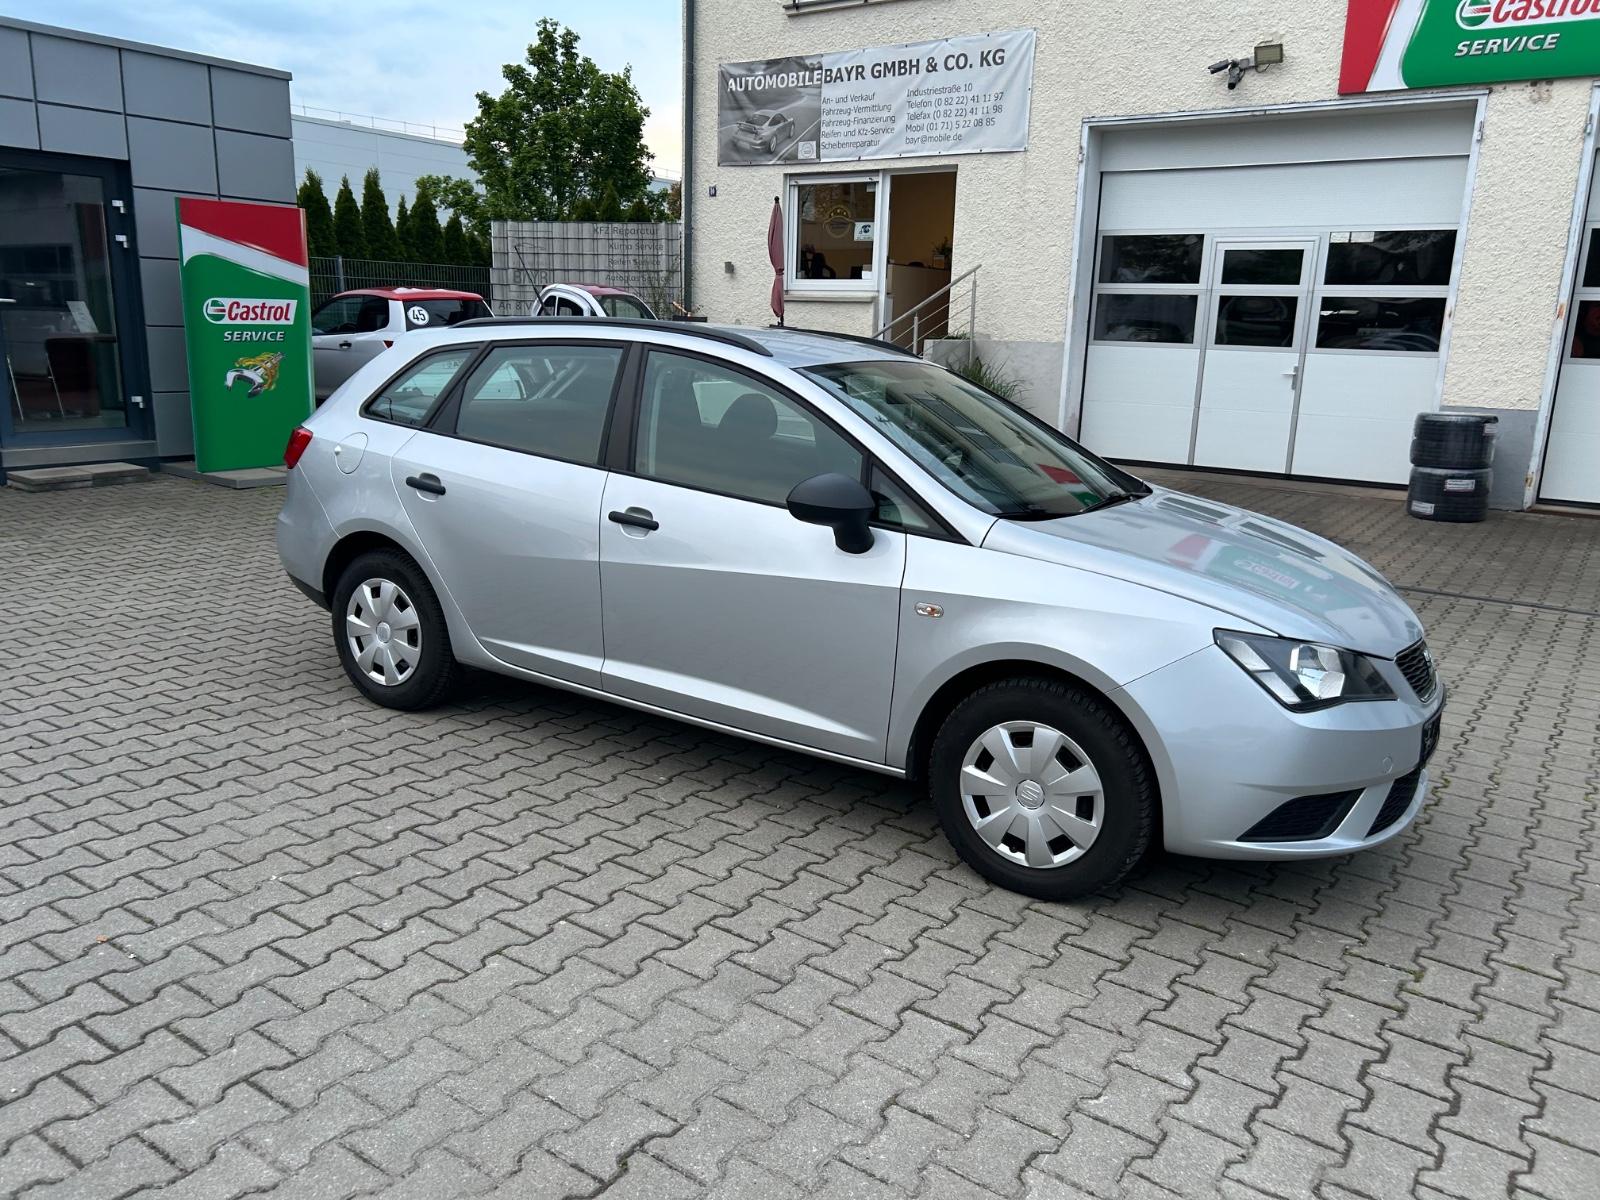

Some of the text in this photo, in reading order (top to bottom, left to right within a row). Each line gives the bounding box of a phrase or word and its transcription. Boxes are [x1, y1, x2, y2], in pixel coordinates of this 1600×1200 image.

[1454, 33, 1560, 57] SERVICE
[727, 48, 1005, 92] AUTOMOBILE BAYR GMBH & CO. KG
[906, 83, 973, 98] Industriestraße 10
[821, 92, 875, 104] An- und Verkauf
[906, 92, 1004, 109] Telefon (0 82 22) 41 11 97
[822, 103, 892, 116] Fahrzeug-Vermittlung
[906, 104, 1003, 121] Telefax (0 82 22) 41 11 98
[821, 115, 896, 128] Fahrzeug-Finanzierung
[905, 122, 925, 133] Mobil
[926, 121, 938, 133] (01
[940, 120, 953, 132] 71)
[961, 118, 972, 128] 22
[973, 118, 984, 128] 08
[985, 117, 996, 127] 85
[821, 126, 895, 138] Reifen und Kfz-Service
[905, 132, 963, 146] bayr@mobile.de
[820, 139, 880, 150] Scheibenreparatur
[227, 301, 291, 321] Castrol
[412, 309, 426, 321] 45
[223, 331, 285, 342] SERVICE
